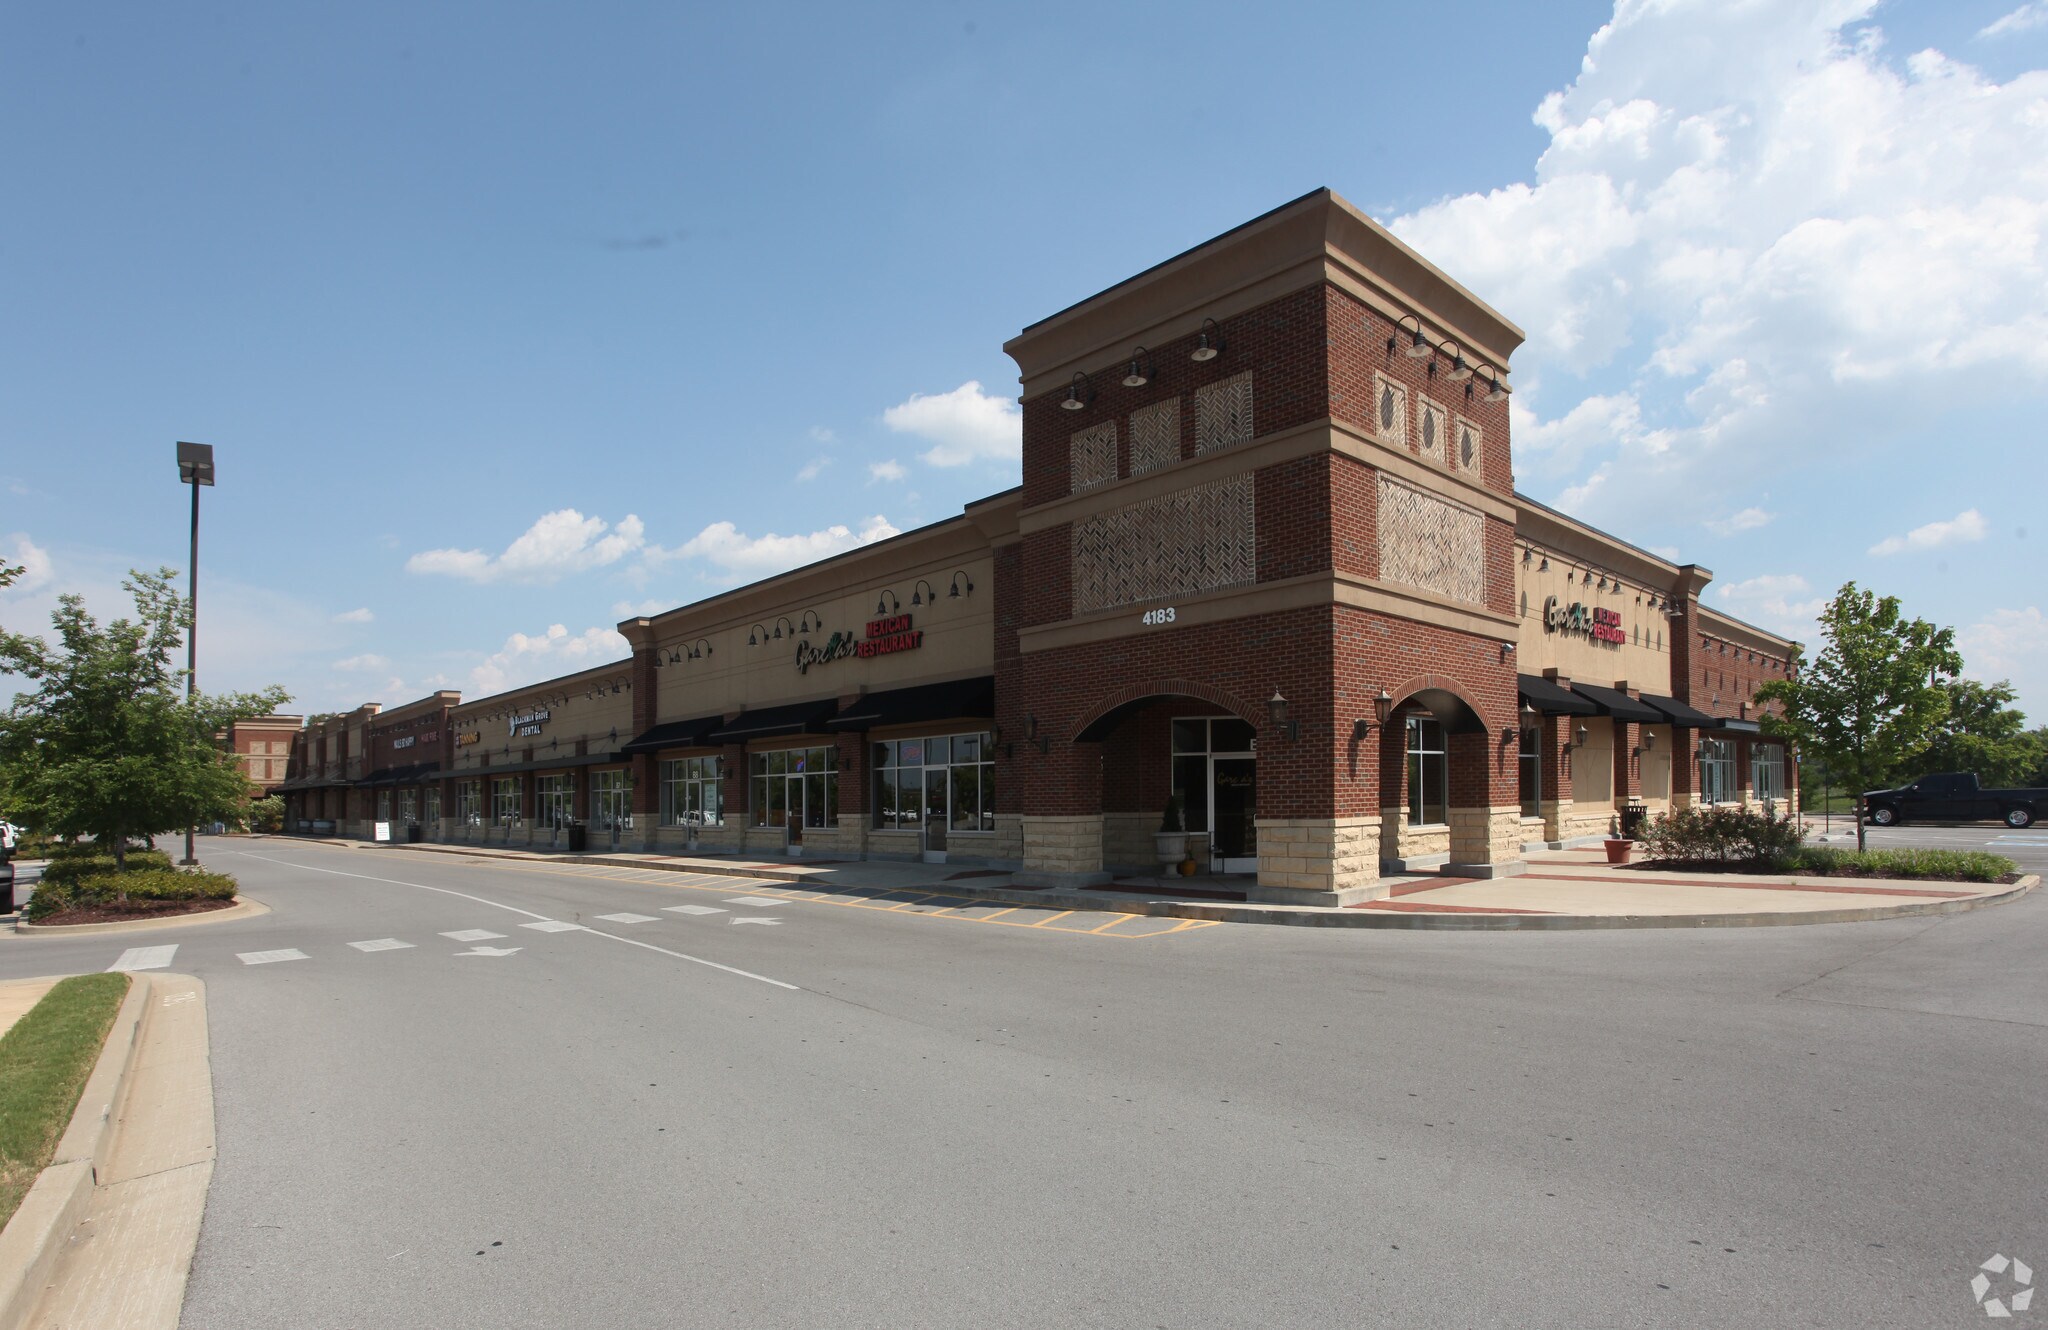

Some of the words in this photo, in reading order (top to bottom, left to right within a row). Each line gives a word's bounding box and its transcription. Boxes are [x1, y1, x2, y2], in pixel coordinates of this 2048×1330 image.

[866, 613, 911, 638] MEXICAN
[1142, 607, 1176, 626] 4183
[1597, 607, 1621, 627] MEXICAN
[1593, 622, 1626, 645] RESTAURANT
[857, 632, 921, 658] RESTAURANT
[515, 714, 534, 725] BLACKMAN
[535, 711, 549, 721] GROVE
[459, 732, 478, 745] TANNING
[521, 725, 541, 737] DENTAL
